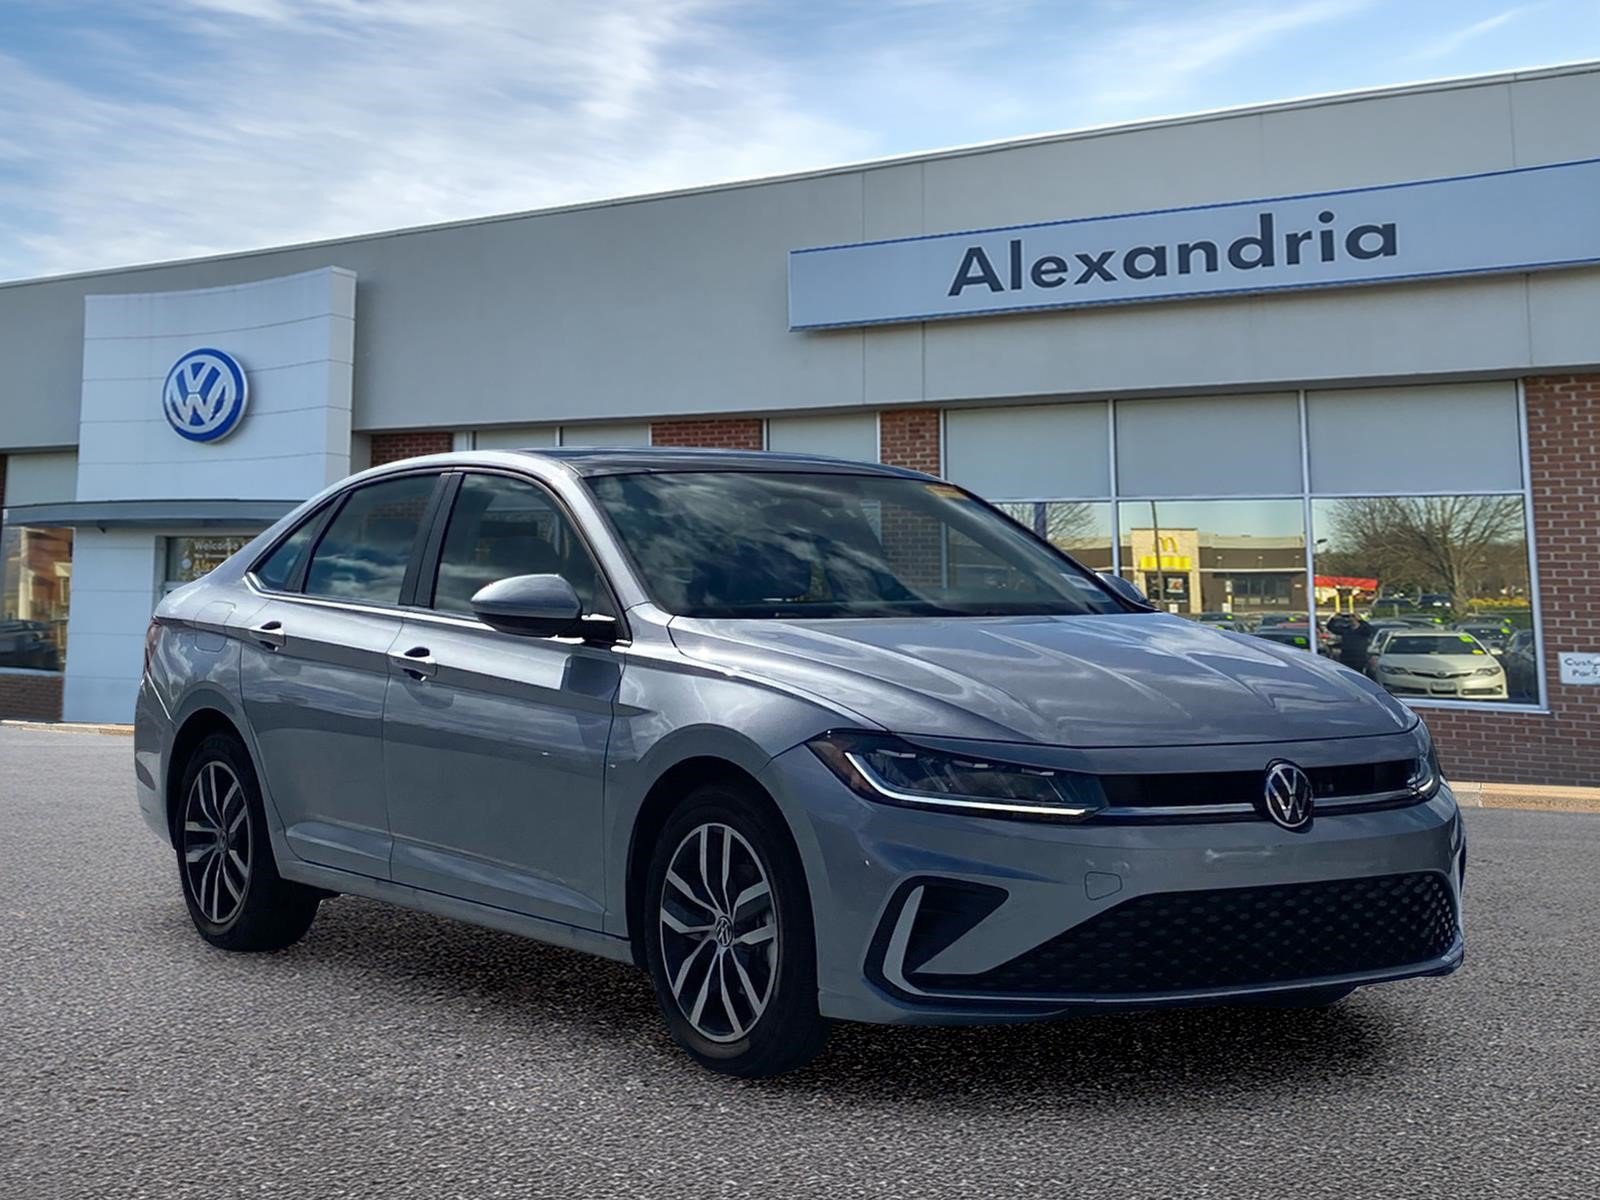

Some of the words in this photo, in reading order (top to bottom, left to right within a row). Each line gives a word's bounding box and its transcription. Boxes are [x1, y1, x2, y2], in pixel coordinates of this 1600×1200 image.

[948, 211, 1397, 297] Alexandria
[164, 349, 245, 441] VW
[194, 541, 239, 550] Welcome
[1265, 764, 1313, 827] VW
